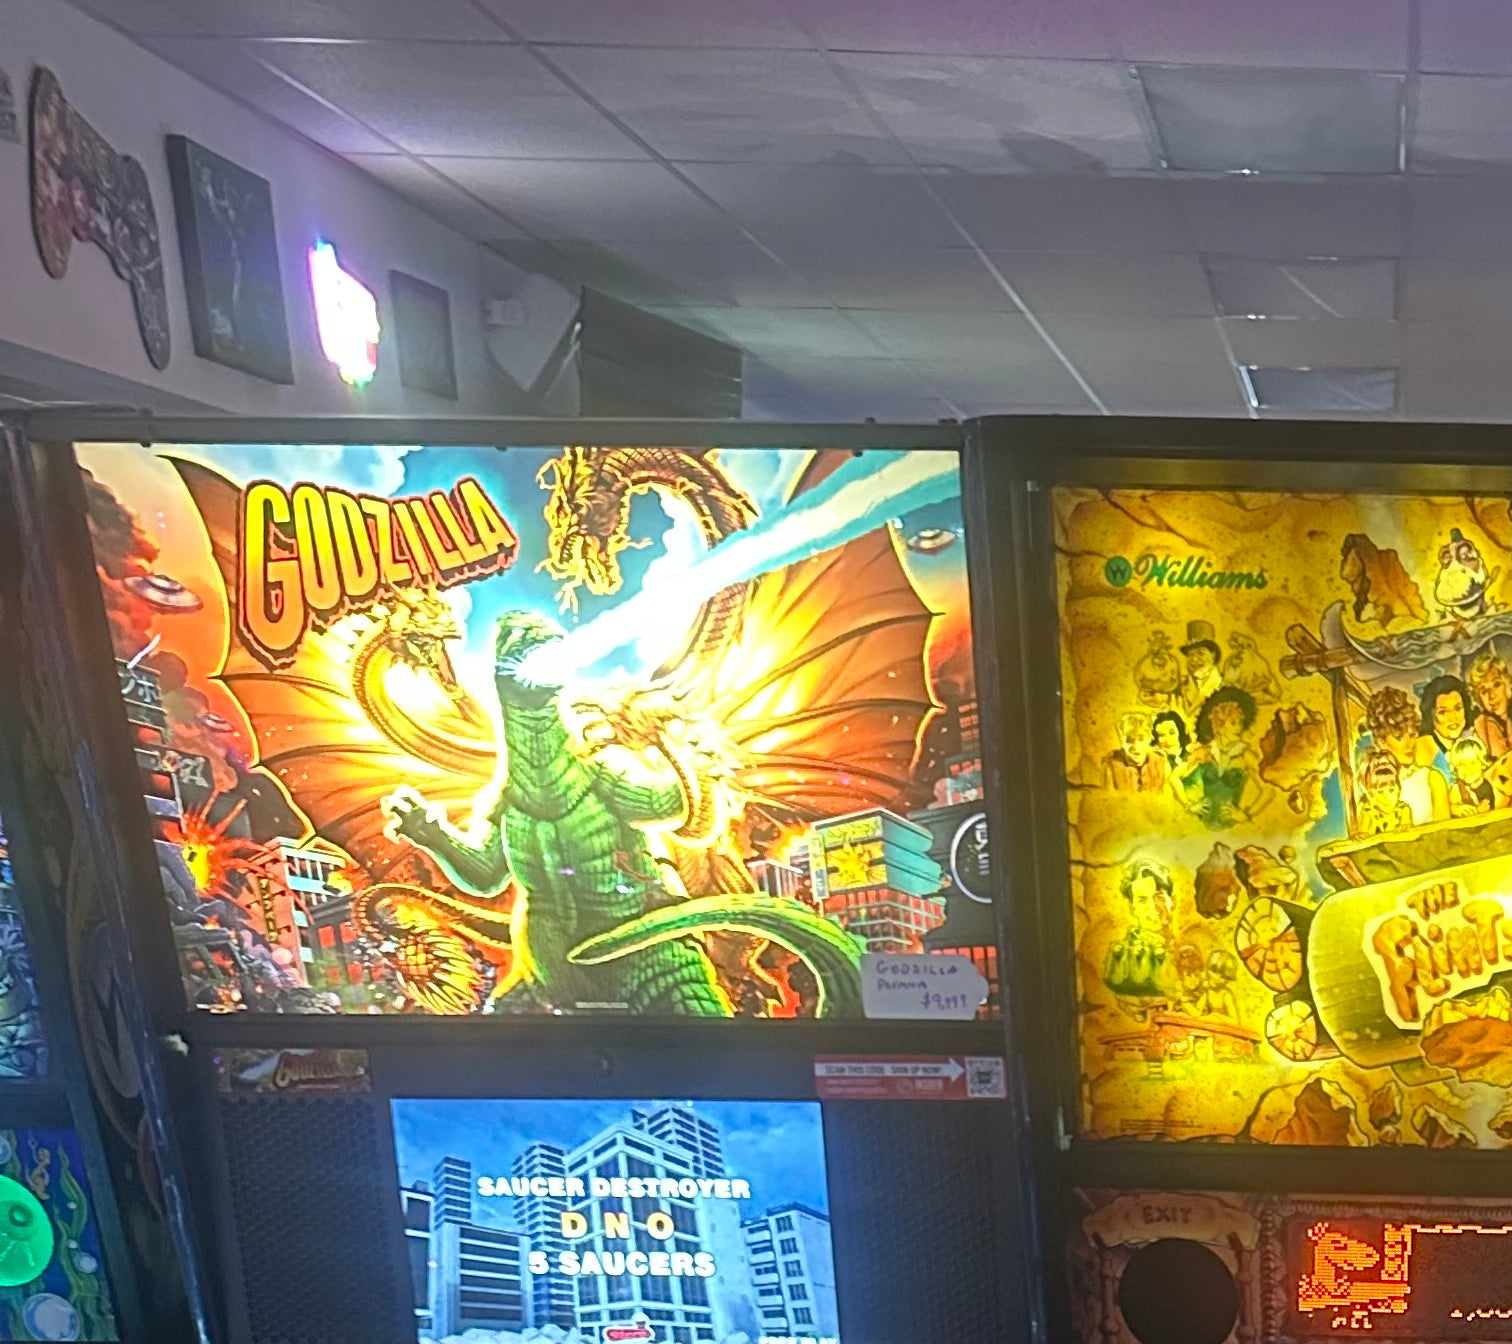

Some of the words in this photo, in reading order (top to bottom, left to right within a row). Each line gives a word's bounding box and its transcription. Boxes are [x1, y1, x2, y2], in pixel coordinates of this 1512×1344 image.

[243, 477, 518, 666] GODZILLA
[1134, 552, 1268, 589] Williams
[1406, 881, 1460, 920] THE
[876, 959, 959, 976] GODZILLA
[477, 1175, 586, 1199] SAUCER
[591, 1176, 752, 1200] DESTROYER
[560, 1211, 588, 1240] D
[603, 1211, 630, 1240] N
[646, 1211, 676, 1240] O
[1142, 1205, 1192, 1224] EXIT
[528, 1250, 550, 1276] 5
[559, 1251, 717, 1278] SAUCERS
